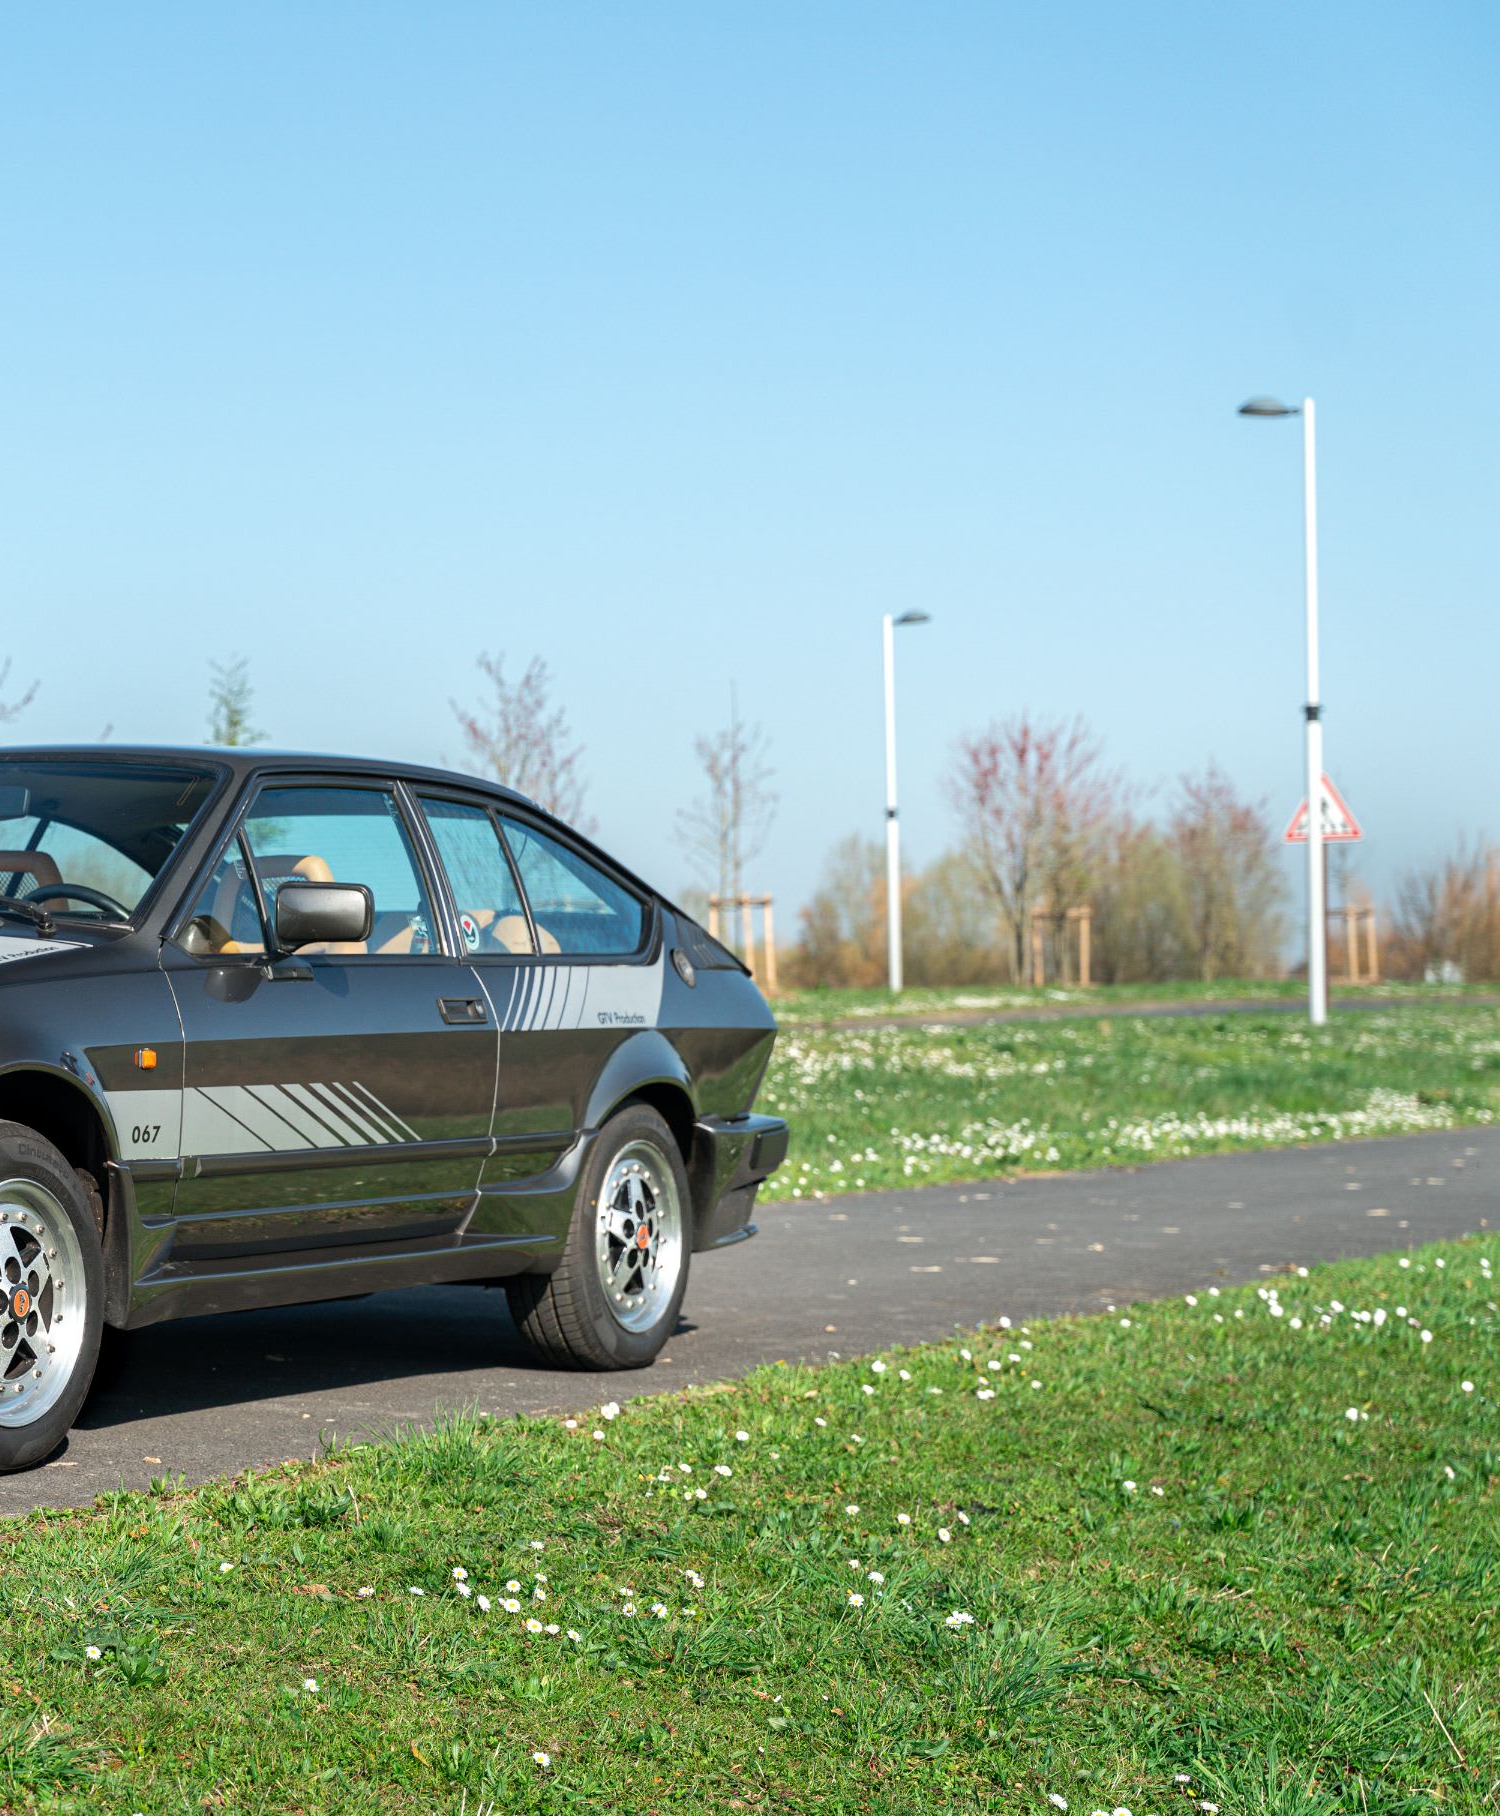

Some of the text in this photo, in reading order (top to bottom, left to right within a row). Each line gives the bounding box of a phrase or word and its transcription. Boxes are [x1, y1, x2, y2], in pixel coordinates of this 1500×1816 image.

[8, 946, 59, 958] Production
[597, 1011, 646, 1025] GTV Production
[132, 1125, 161, 1144] 067
